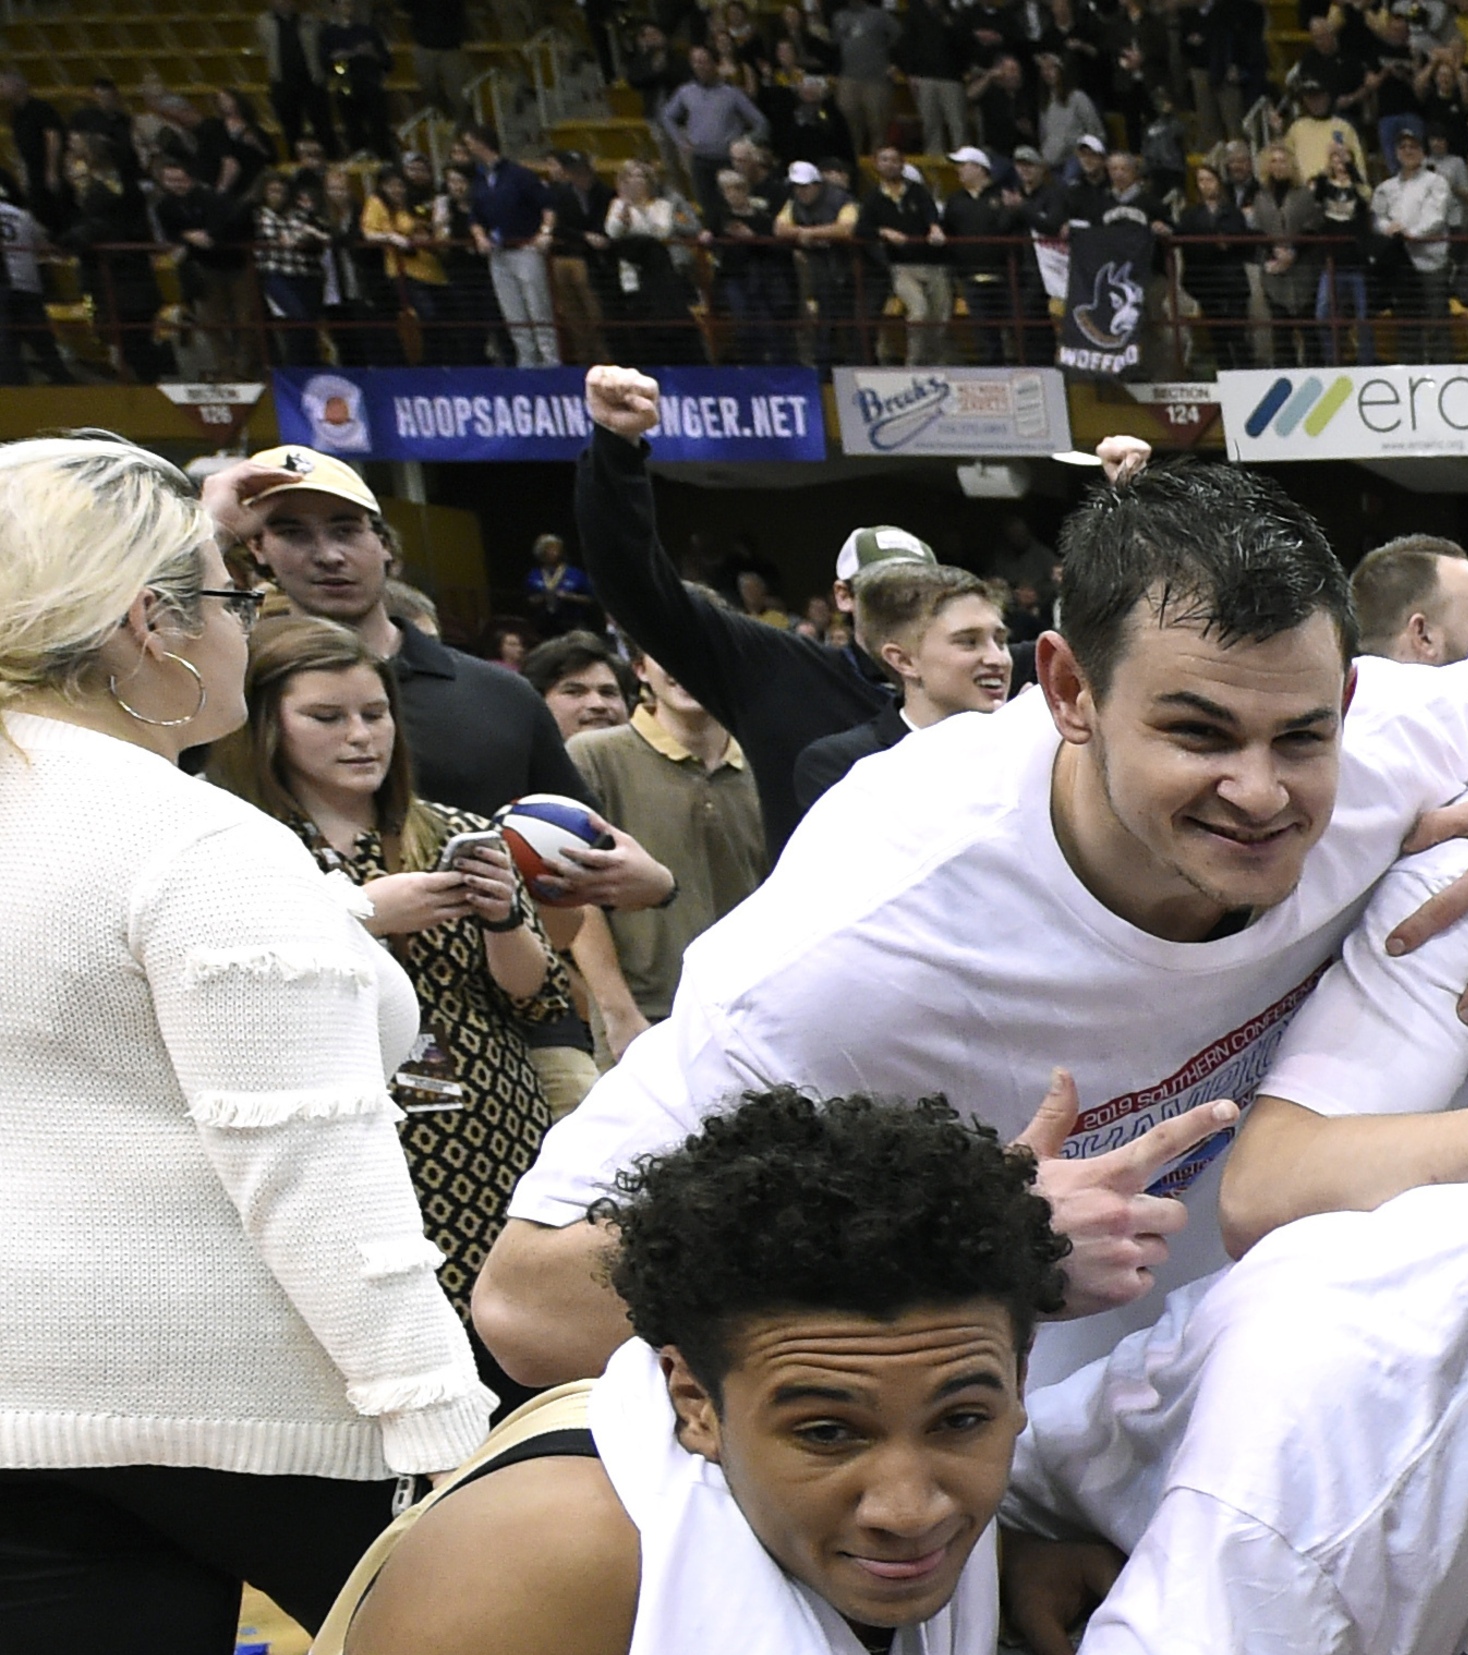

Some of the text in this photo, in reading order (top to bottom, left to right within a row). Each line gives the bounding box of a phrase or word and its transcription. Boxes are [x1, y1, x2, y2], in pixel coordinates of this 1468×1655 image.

[1165, 405, 1200, 424] 124
[1083, 1099, 1133, 1131] 2019
[1137, 1042, 1231, 1110] SOUTHERN
